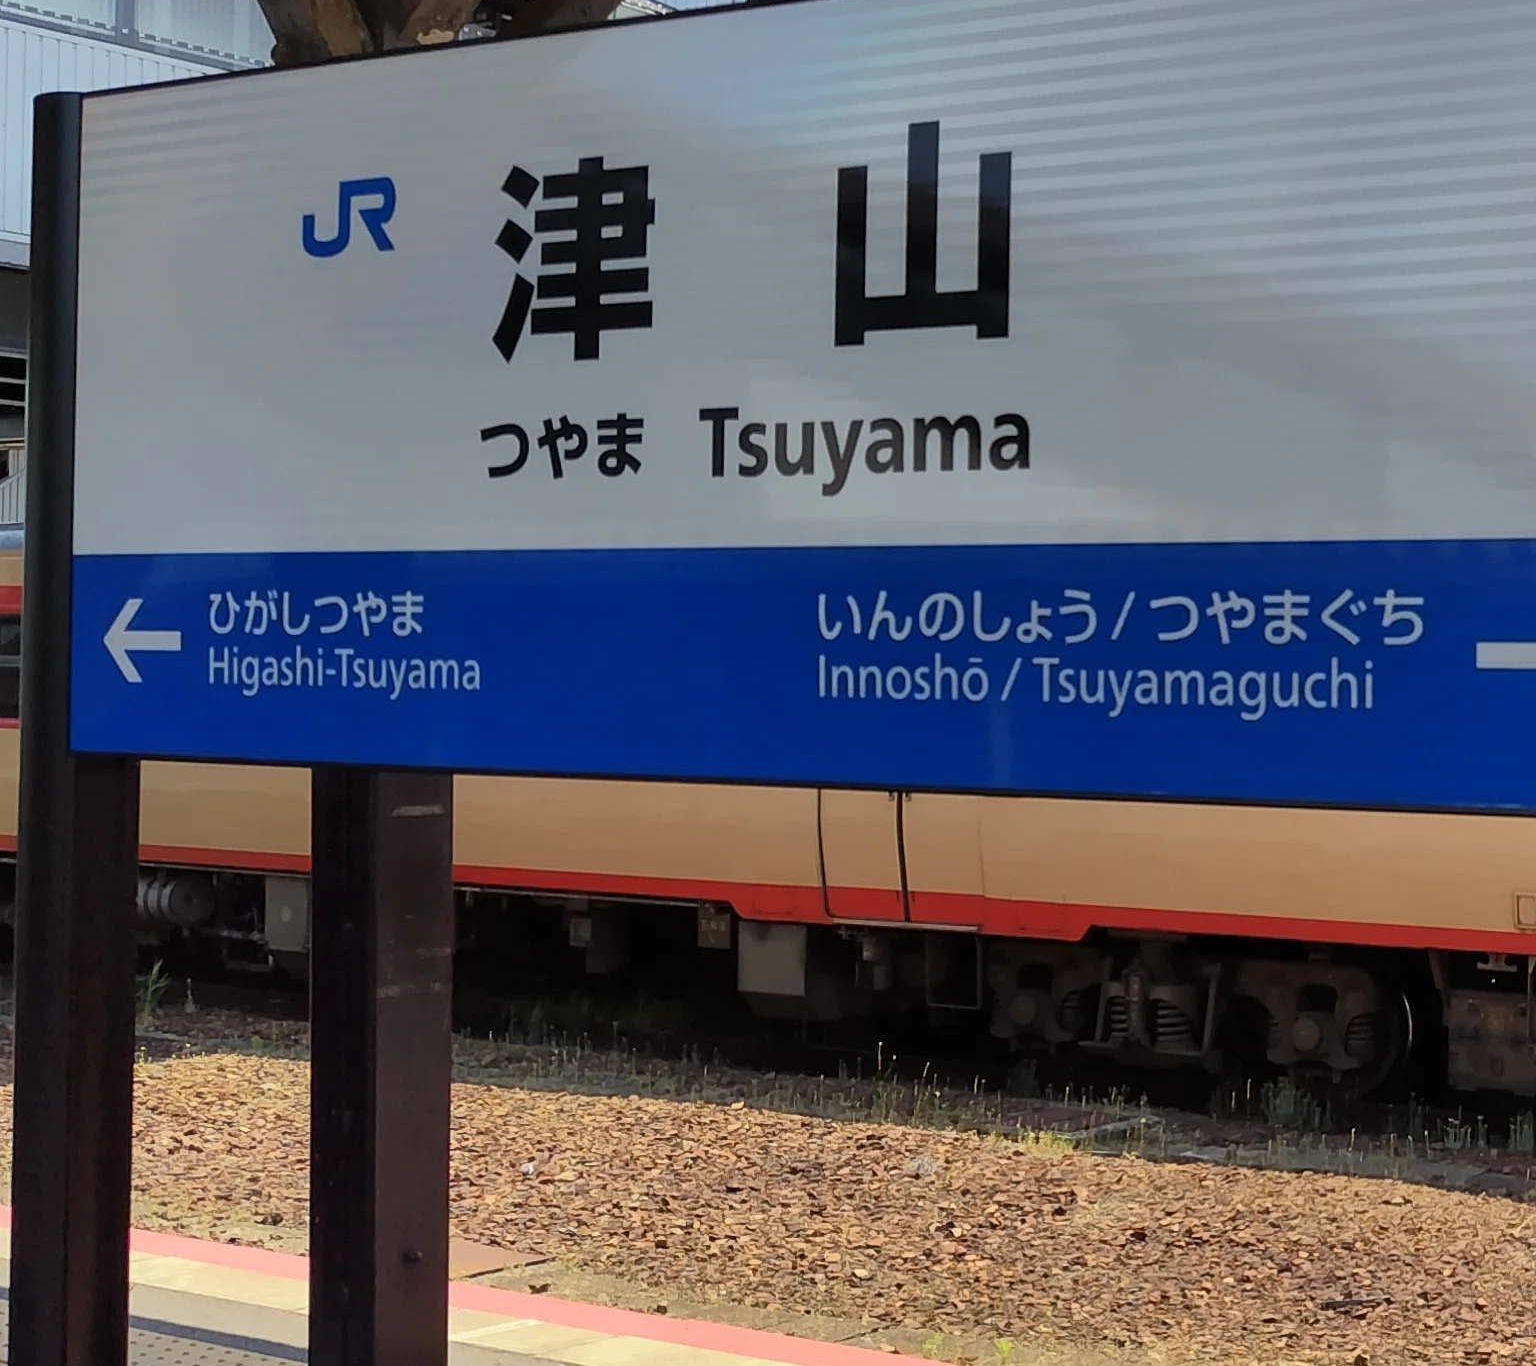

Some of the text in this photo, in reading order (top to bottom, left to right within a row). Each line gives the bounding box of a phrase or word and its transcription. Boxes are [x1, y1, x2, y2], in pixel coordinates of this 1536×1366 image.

[301, 176, 398, 259] JR
[491, 121, 1014, 365] 津山
[479, 411, 646, 481] つやま
[699, 407, 1032, 498] Tsuyama
[208, 591, 425, 637] ひがしつやま
[209, 647, 481, 700] Higashi-Tsuyama
[1033, 658, 1374, 721] Tsuyamaguchi
